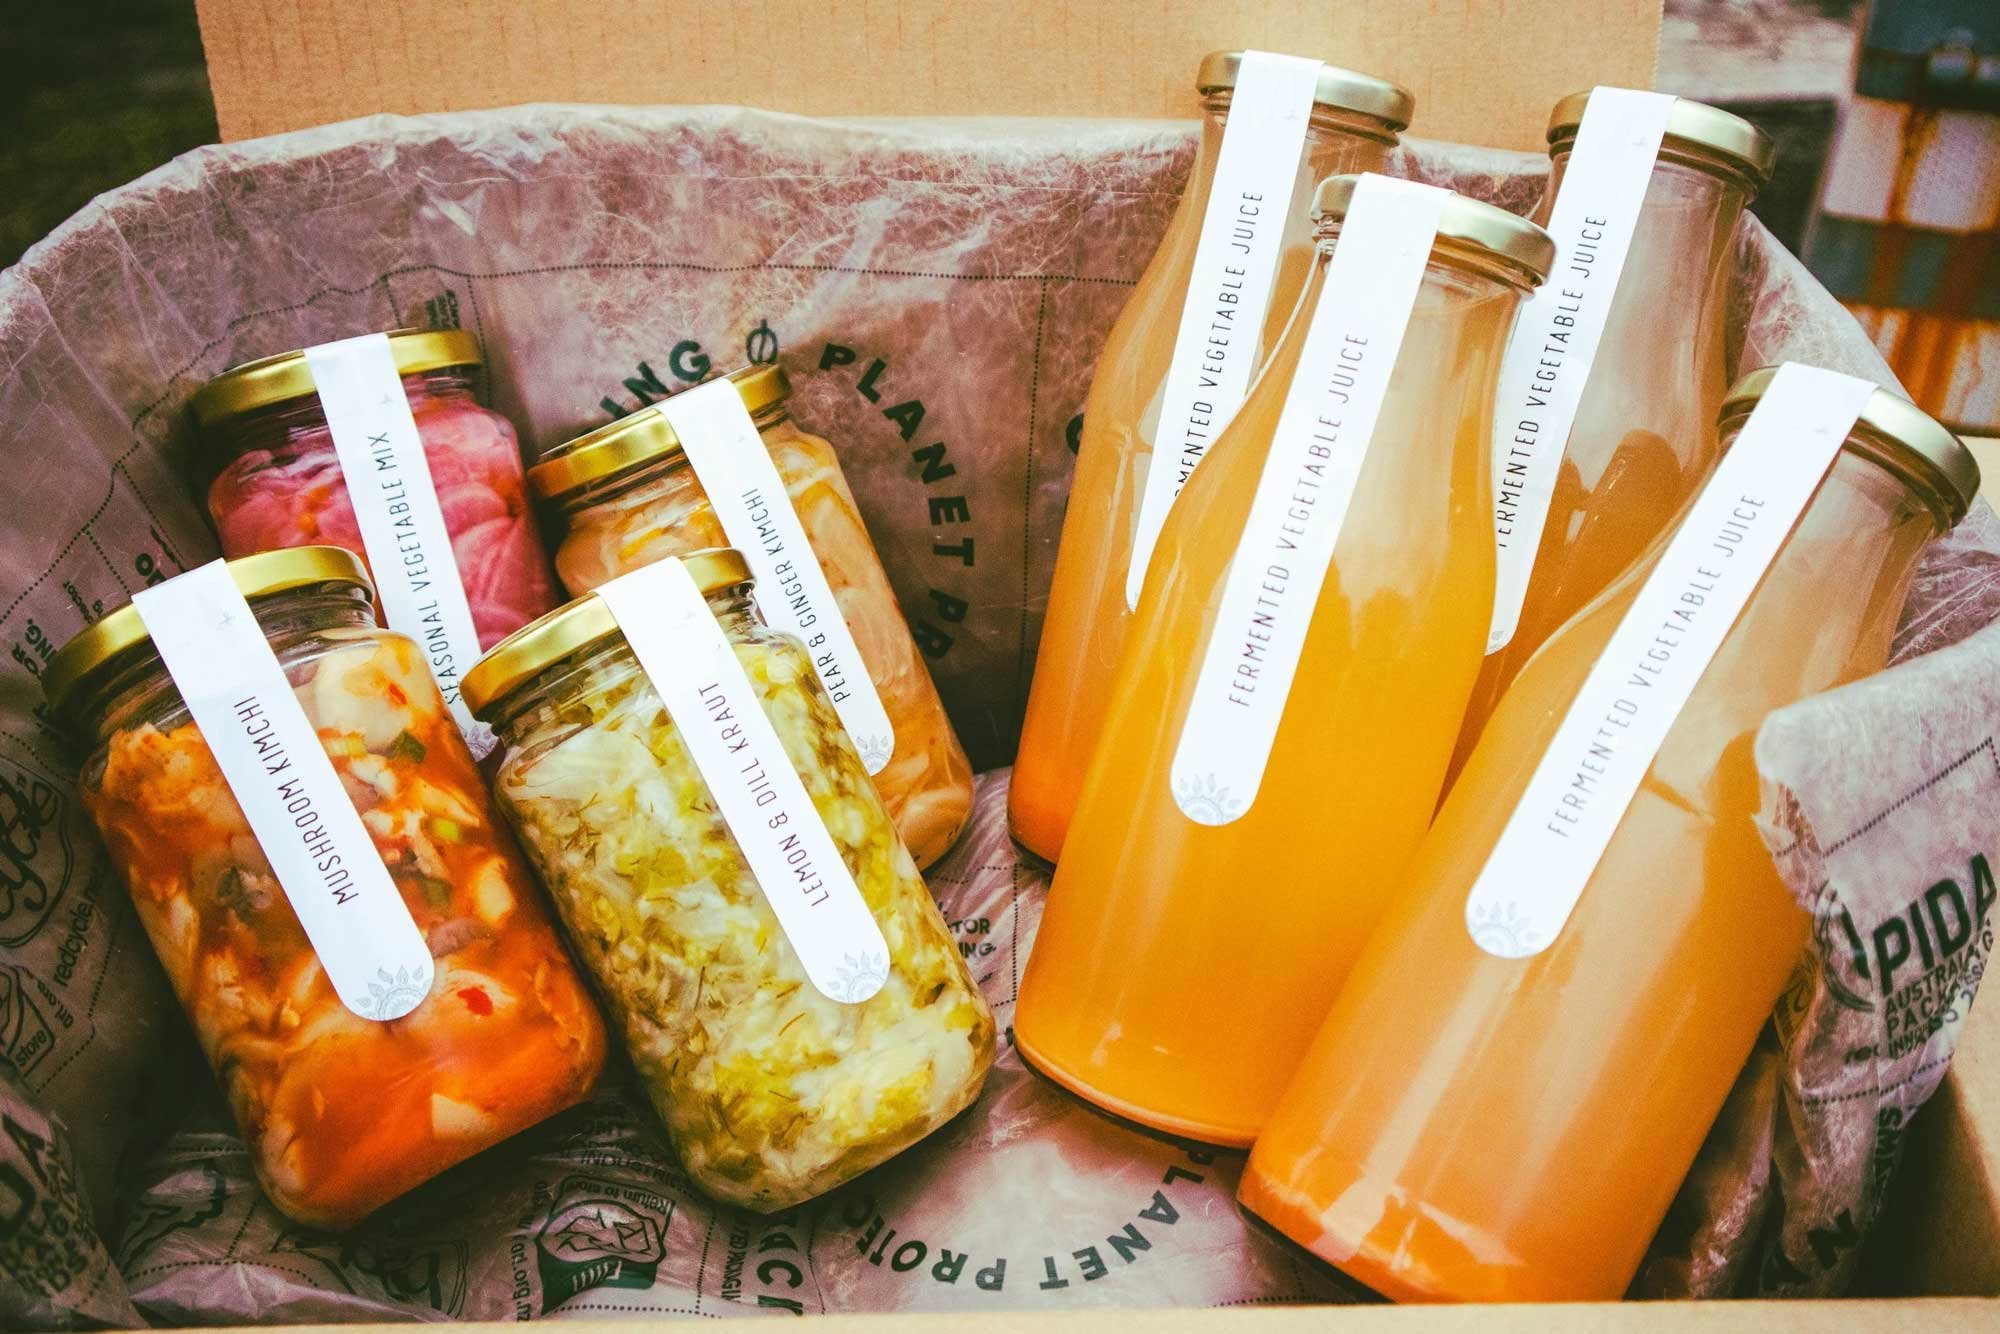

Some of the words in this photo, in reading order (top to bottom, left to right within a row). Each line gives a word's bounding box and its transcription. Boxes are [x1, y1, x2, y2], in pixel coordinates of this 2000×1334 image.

[1198, 265, 1246, 388] VEGETABLE
[1231, 191, 1263, 254] JUICE
[1526, 288, 1584, 406] VEGETABLE
[1570, 215, 1607, 278] JUICE
[367, 432, 398, 471] MIX
[819, 343, 975, 567] PLANET
[381, 478, 431, 592] VEGETABLE
[741, 488, 784, 556] KIMCHI
[1228, 564, 1290, 707] FERMENTED
[1276, 415, 1342, 550] VEGETABLE
[1328, 333, 1369, 404] JUICE
[775, 560, 817, 628] GINGER
[418, 599, 463, 705] SEASONAL
[808, 632, 826, 648] &
[817, 652, 851, 703] PEAR
[1547, 698, 1638, 837] FERMENTED
[1628, 565, 1721, 688] VEGETABLE
[1713, 495, 1765, 558] JUICE
[233, 696, 292, 775] KIMCHI
[698, 682, 749, 754] KRAUT
[741, 757, 777, 806] DILL
[277, 778, 359, 905] MUSHROOM
[767, 811, 789, 829] &
[778, 833, 830, 907] LEMON
